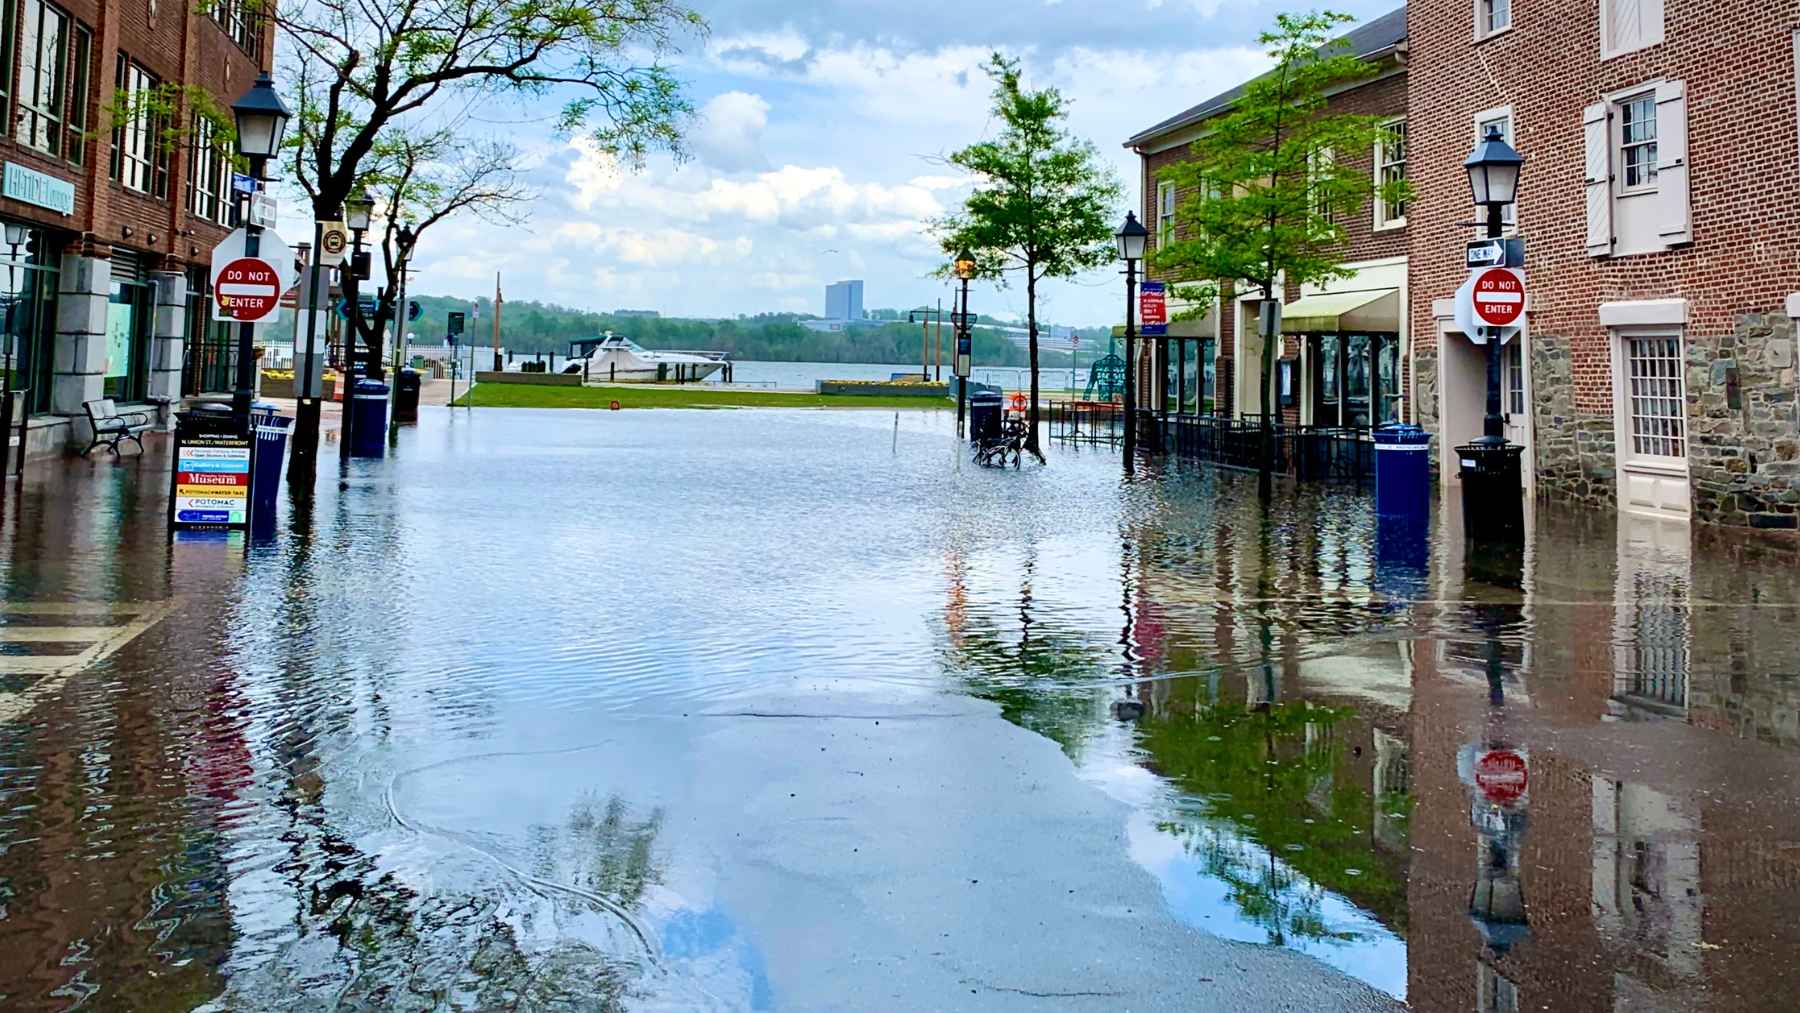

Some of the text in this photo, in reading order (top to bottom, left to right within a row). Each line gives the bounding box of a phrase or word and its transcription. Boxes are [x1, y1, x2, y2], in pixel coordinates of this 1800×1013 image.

[227, 270, 270, 282] DO NOT
[1482, 281, 1516, 290] DO NOT
[229, 297, 264, 309] ENTER
[1485, 304, 1513, 314] ENTER
[188, 473, 237, 485] Museum
